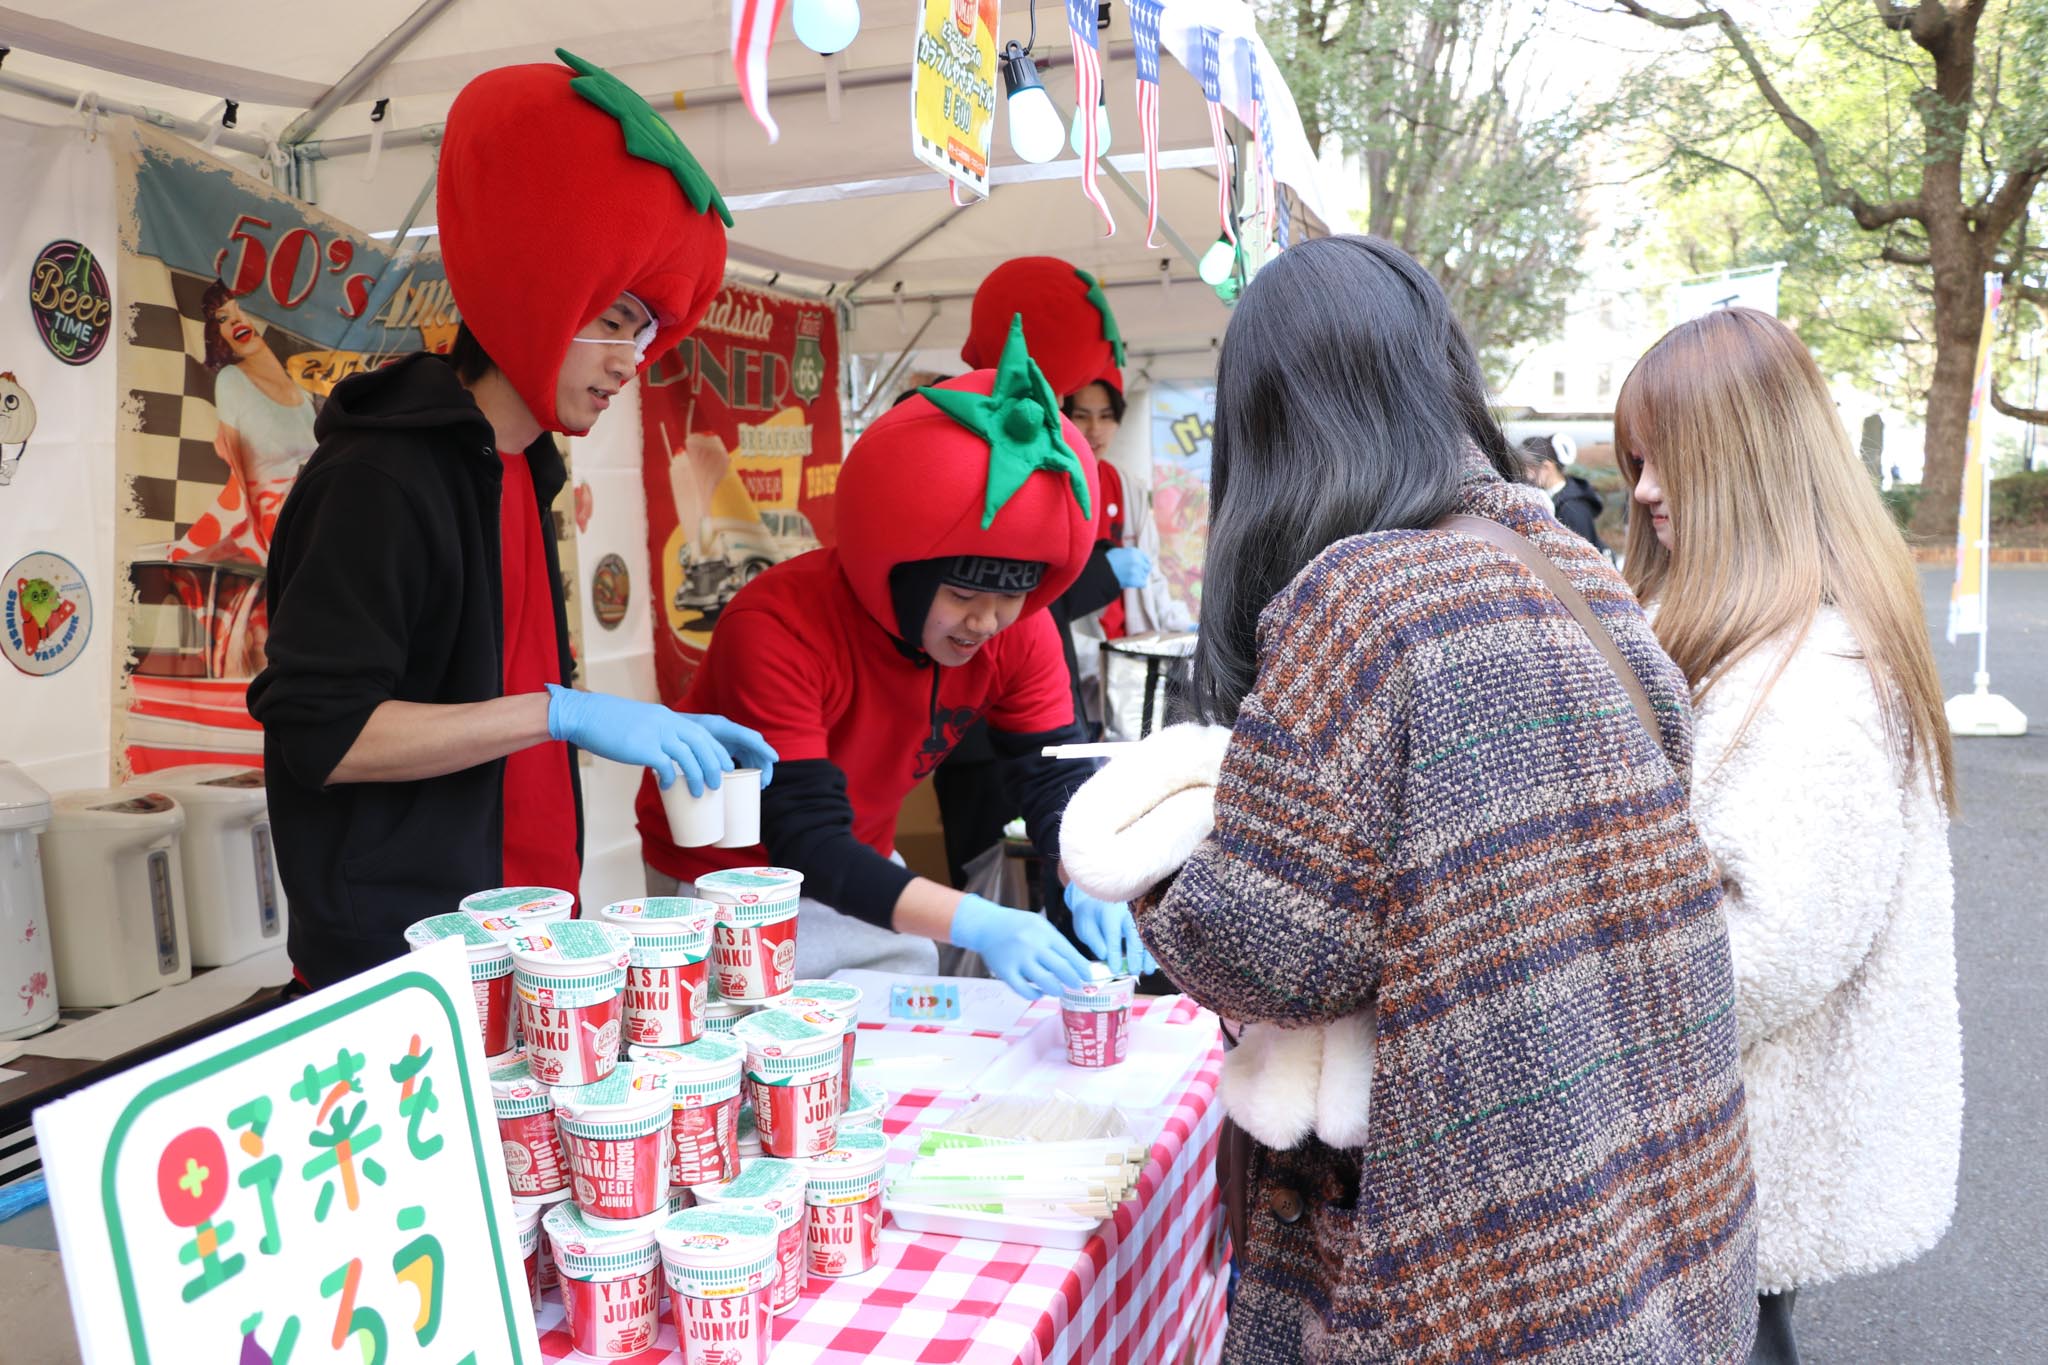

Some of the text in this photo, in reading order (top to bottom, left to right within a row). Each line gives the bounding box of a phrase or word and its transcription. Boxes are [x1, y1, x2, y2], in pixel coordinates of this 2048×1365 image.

[214, 214, 378, 319] 50's
[31, 258, 110, 327] Beer
[54, 311, 93, 343] TIME
[799, 356, 819, 391] 66
[952, 556, 1044, 588] UPRE
[714, 928, 752, 946] ASA
[712, 948, 752, 967] UNKU
[626, 966, 669, 988] ASA
[623, 989, 670, 1011] UNKU
[802, 1075, 839, 1104] YAS
[529, 1139, 561, 1190] JUNKU
[676, 1132, 701, 1183] JUNKU
[696, 1126, 721, 1182] YASA
[599, 1180, 634, 1195] VEGE
[811, 1205, 853, 1225] ASA
[600, 1268, 658, 1303] YASA
[603, 1290, 658, 1324] JUNKU
[685, 1295, 750, 1319] YASA
[690, 1319, 750, 1342] JUNKU
